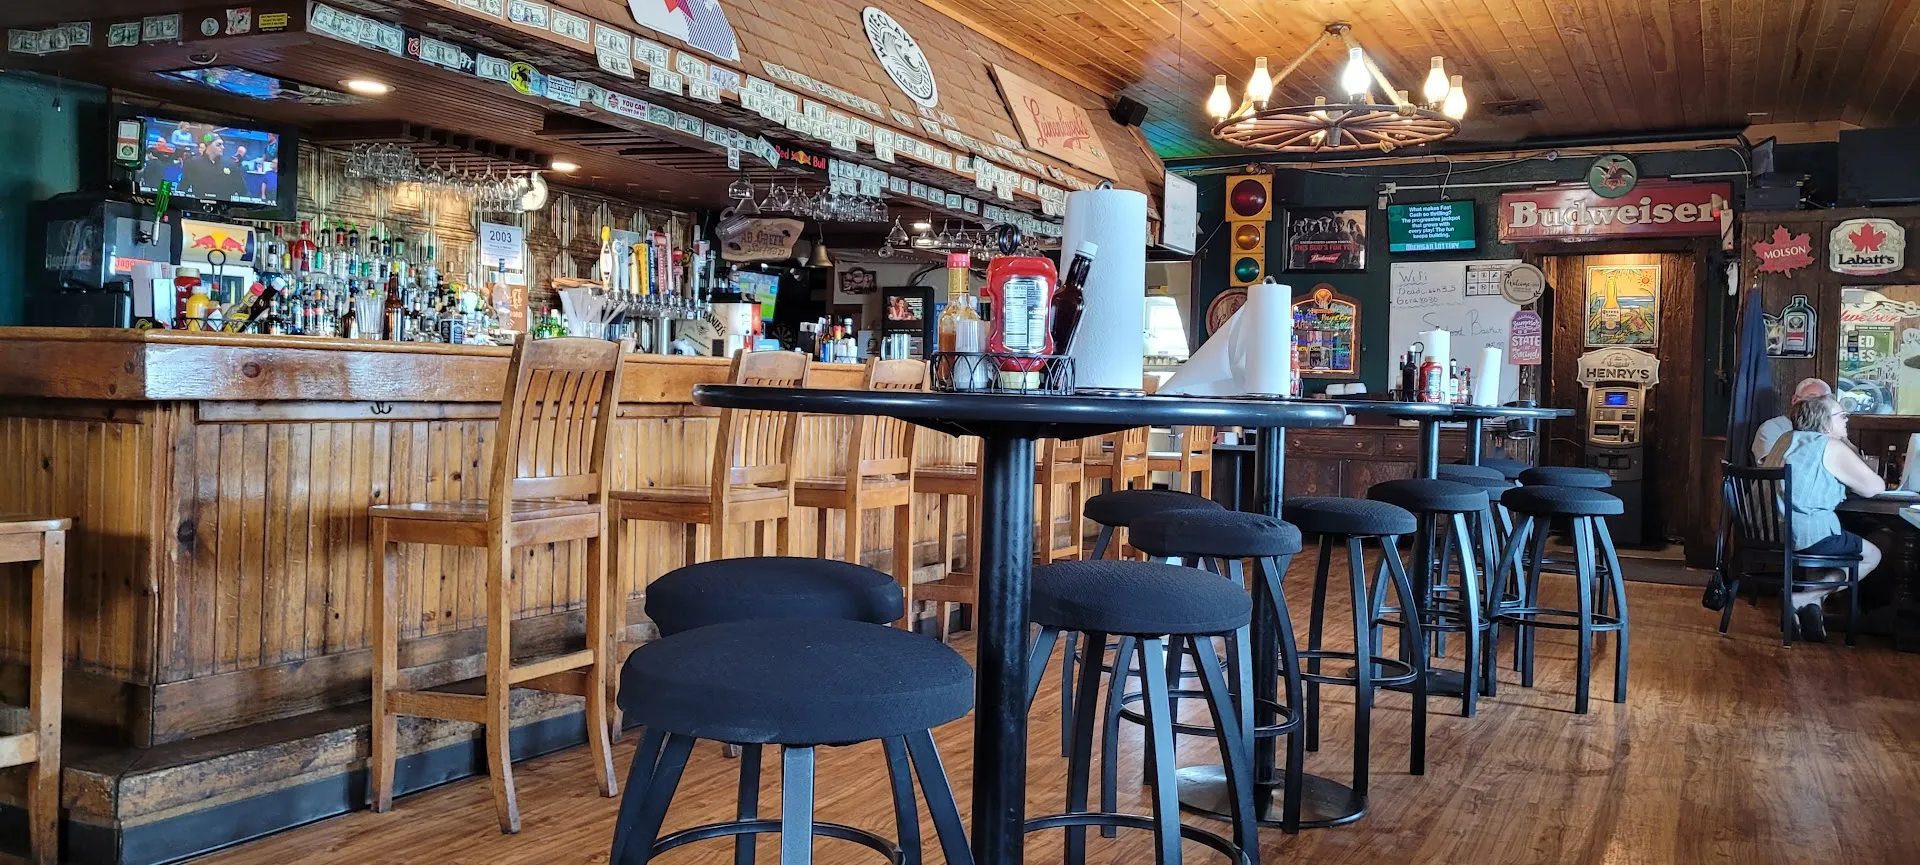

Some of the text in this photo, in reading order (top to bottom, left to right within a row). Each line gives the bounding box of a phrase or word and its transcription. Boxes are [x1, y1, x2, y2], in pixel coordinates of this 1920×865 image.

[868, 14, 914, 58] WHITE CLAW
[619, 106, 633, 114] COUNT
[622, 99, 646, 111] YOU CAN
[775, 145, 826, 169] Red Bull
[1508, 196, 1714, 228] Budweiser
[490, 230, 512, 243] 2003
[1763, 245, 1807, 259] MOLSON
[1838, 253, 1895, 265] Labatt's
[1506, 279, 1530, 288] Welcome
[1511, 335, 1541, 347] STATE
[1586, 367, 1650, 379] HENRY'S
